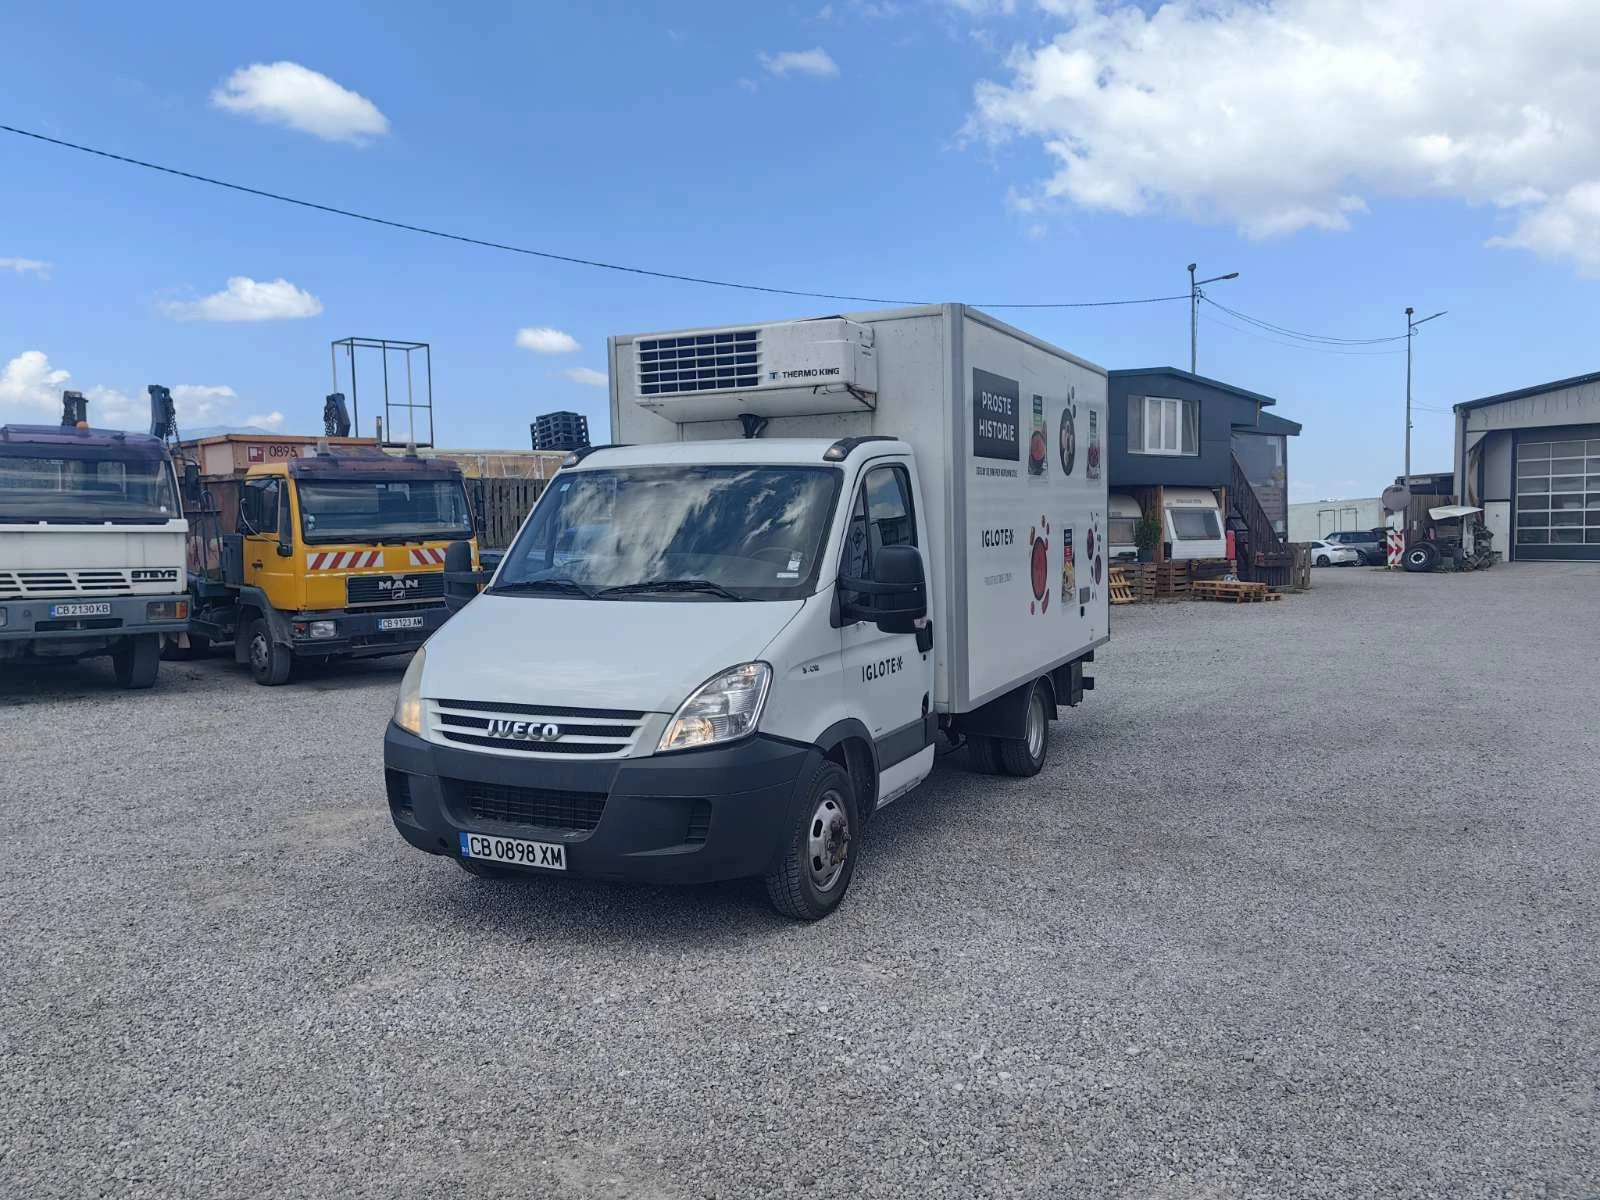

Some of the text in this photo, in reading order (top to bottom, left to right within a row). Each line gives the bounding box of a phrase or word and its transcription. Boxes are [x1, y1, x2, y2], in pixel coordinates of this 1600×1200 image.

[782, 367, 840, 379] THERMO KING
[982, 391, 1012, 416] PROSTE
[979, 419, 1015, 441] HISTORIE
[269, 445, 298, 457] 0895
[981, 528, 1015, 548] IGLOTEX
[131, 570, 178, 578] STEYR
[378, 579, 419, 590] MAN
[56, 606, 69, 615] CB
[71, 604, 94, 615] 2130
[383, 619, 393, 628] CB
[394, 618, 412, 627] 9123
[861, 656, 904, 682] IGLOTEX
[487, 719, 559, 741] IVECO
[470, 837, 563, 867] CB 0898 XM
